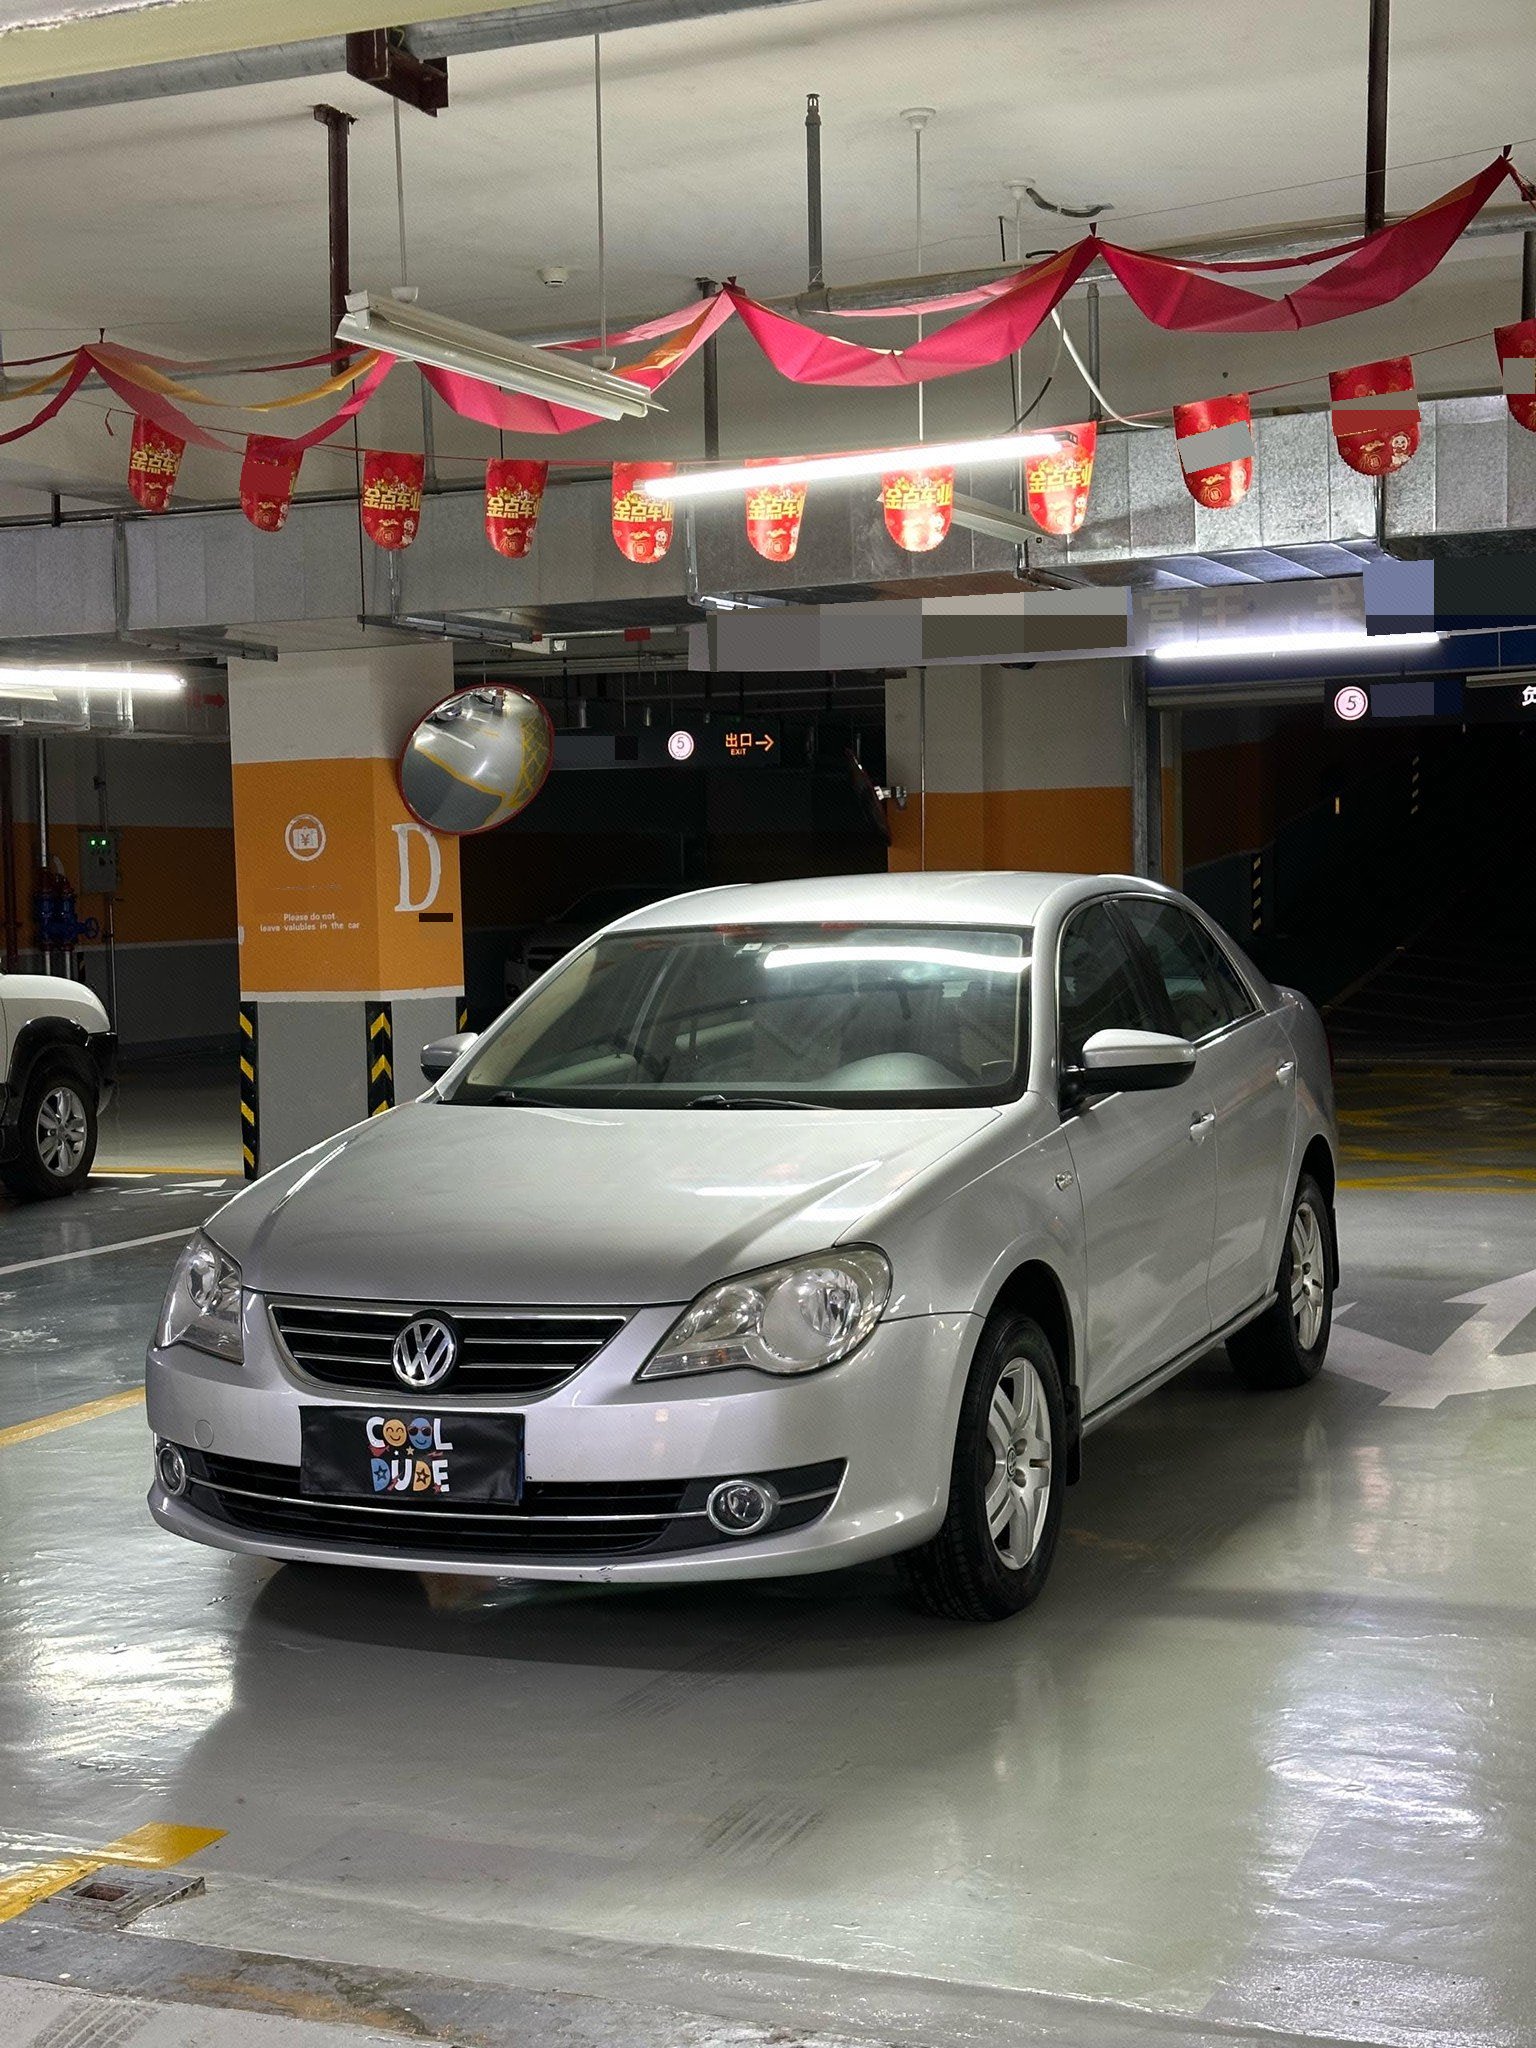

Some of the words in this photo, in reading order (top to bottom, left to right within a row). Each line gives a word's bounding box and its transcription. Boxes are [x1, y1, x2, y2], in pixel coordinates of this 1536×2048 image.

[363, 487, 421, 512] 金点车业
[886, 483, 952, 511] 金点车业
[613, 500, 673, 523] 金点车业
[1345, 695, 1357, 711] 5
[676, 736, 685, 750] 5
[725, 732, 752, 748] 出口
[730, 748, 747, 756] EXIT
[391, 822, 442, 912] D
[283, 913, 308, 921] Please
[310, 913, 321, 921] do
[322, 912, 335, 921] not
[260, 924, 280, 932] leave
[320, 922, 327, 930] in
[331, 922, 344, 930] the
[365, 1416, 453, 1451] COOL
[370, 1457, 451, 1493] DUDE
